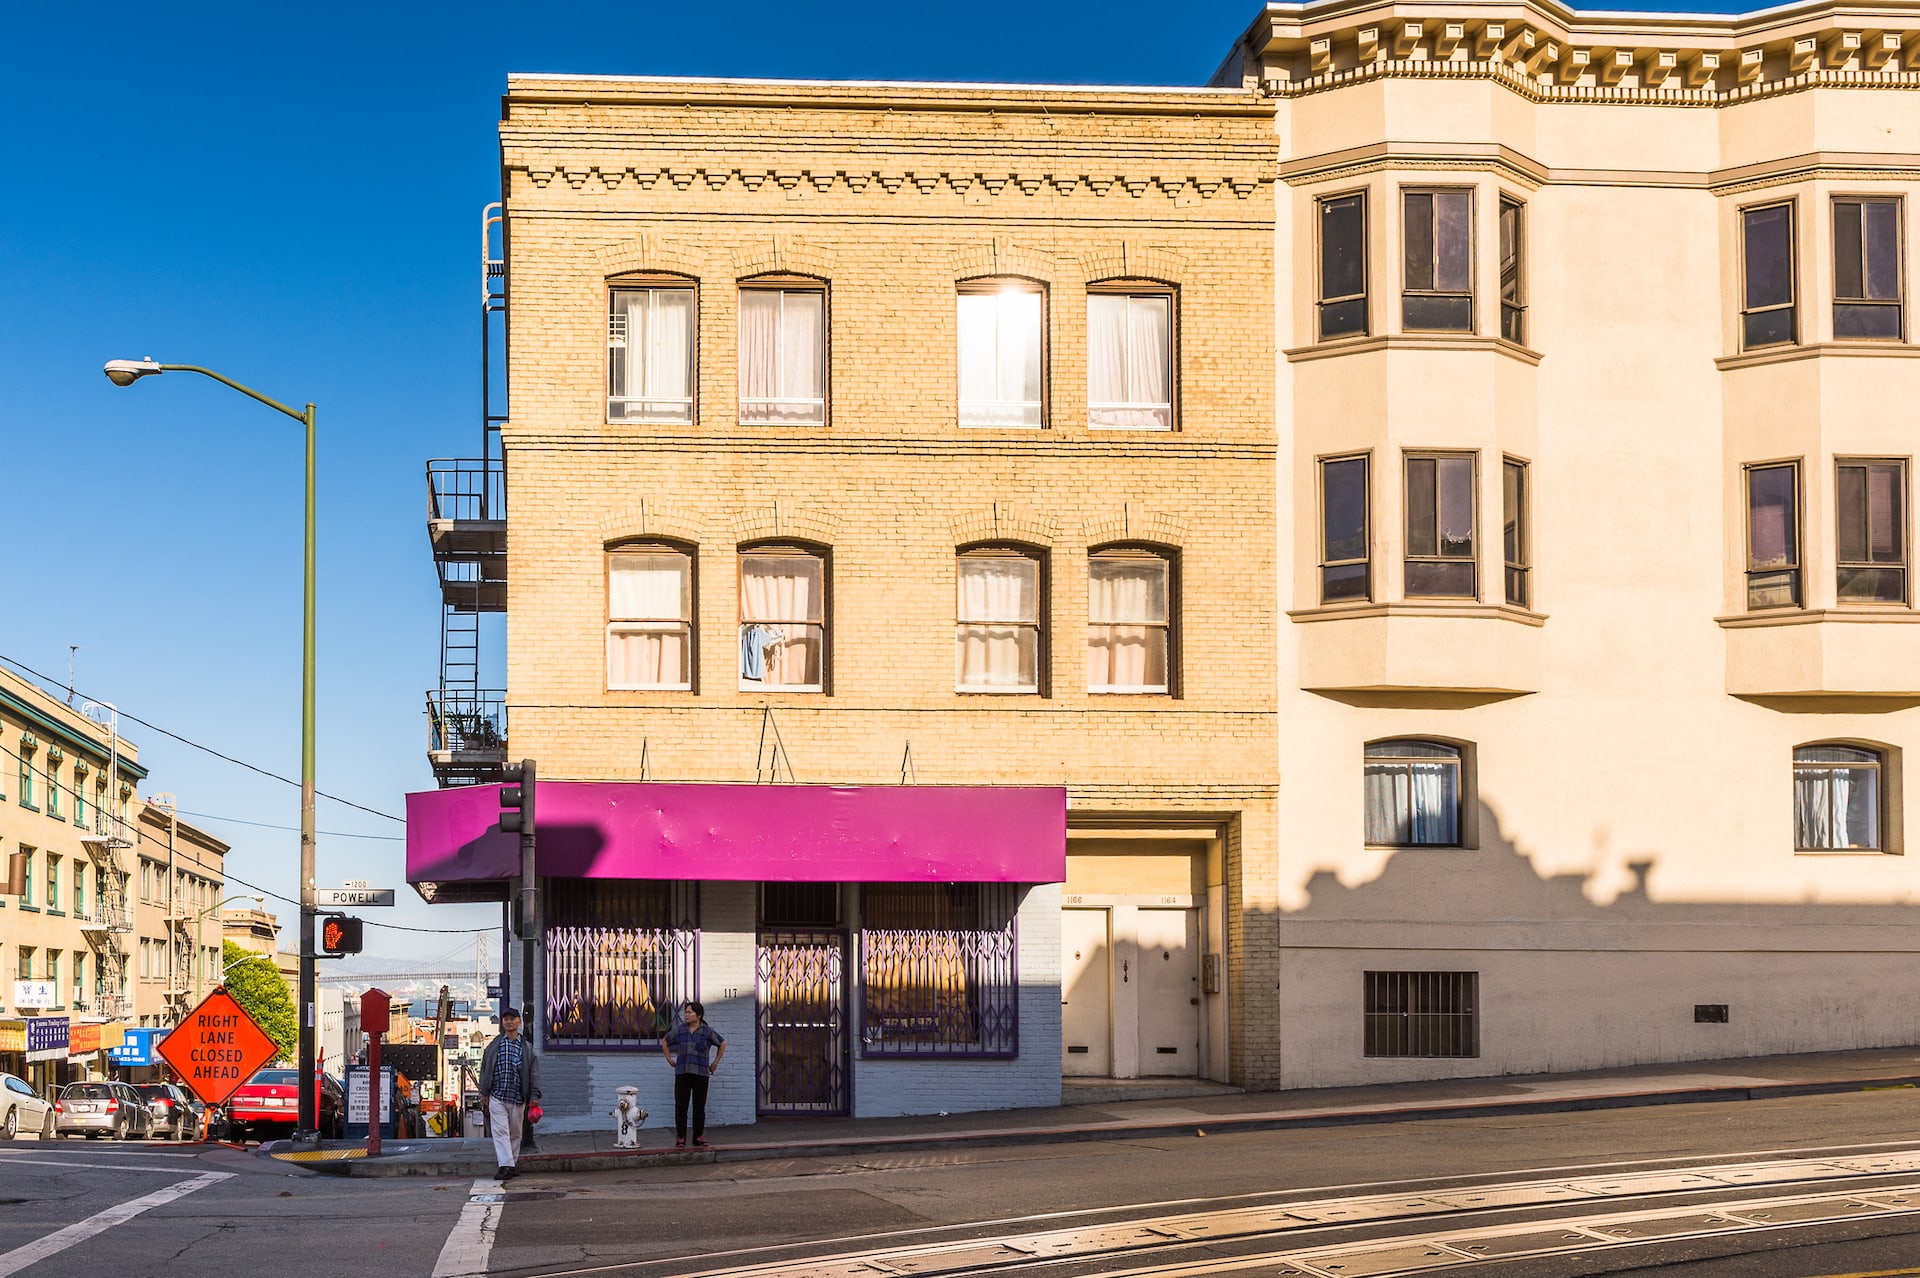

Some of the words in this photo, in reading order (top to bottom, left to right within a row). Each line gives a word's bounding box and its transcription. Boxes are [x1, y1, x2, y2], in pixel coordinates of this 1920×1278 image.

[332, 892, 379, 903] POWELL
[1067, 896, 1082, 904] 1166
[1160, 896, 1177, 904] 1164
[724, 988, 738, 998] 117
[198, 1015, 239, 1027] RIGHT
[200, 1031, 235, 1044] LANE
[190, 1048, 243, 1062] CLOSED
[193, 1066, 240, 1079] AHEAD
[621, 1123, 628, 1135] 8
